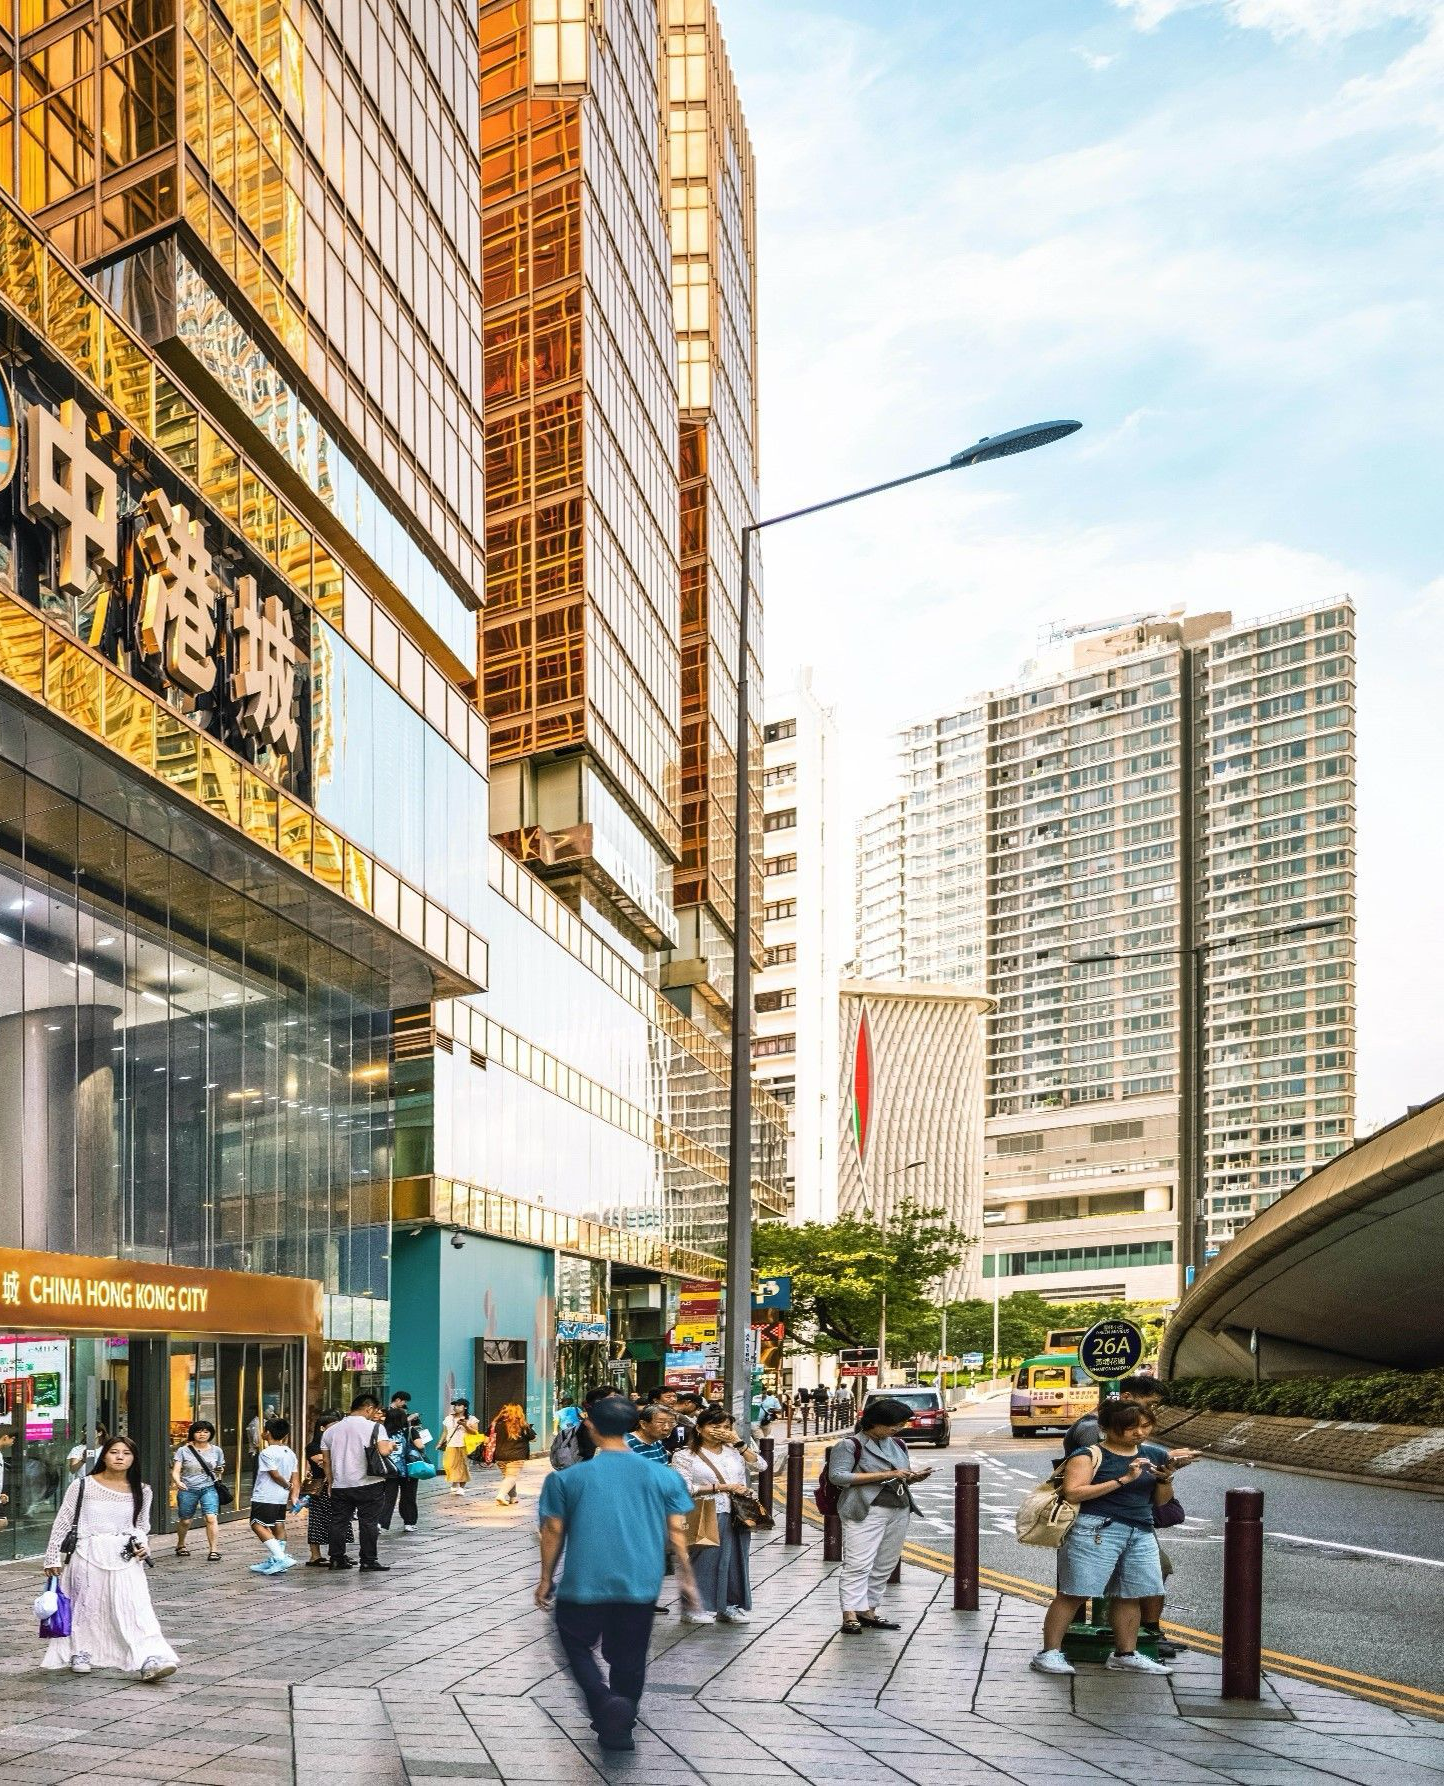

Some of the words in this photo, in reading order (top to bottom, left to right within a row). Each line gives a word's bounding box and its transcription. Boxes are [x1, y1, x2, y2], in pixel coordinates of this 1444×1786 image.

[23, 398, 298, 755] 中港城
[29, 1275, 83, 1305] CHINA
[86, 1280, 133, 1309] HONG
[135, 1283, 176, 1311] KONG
[178, 1286, 208, 1312] CITY
[1092, 1336, 1131, 1355] 26A
